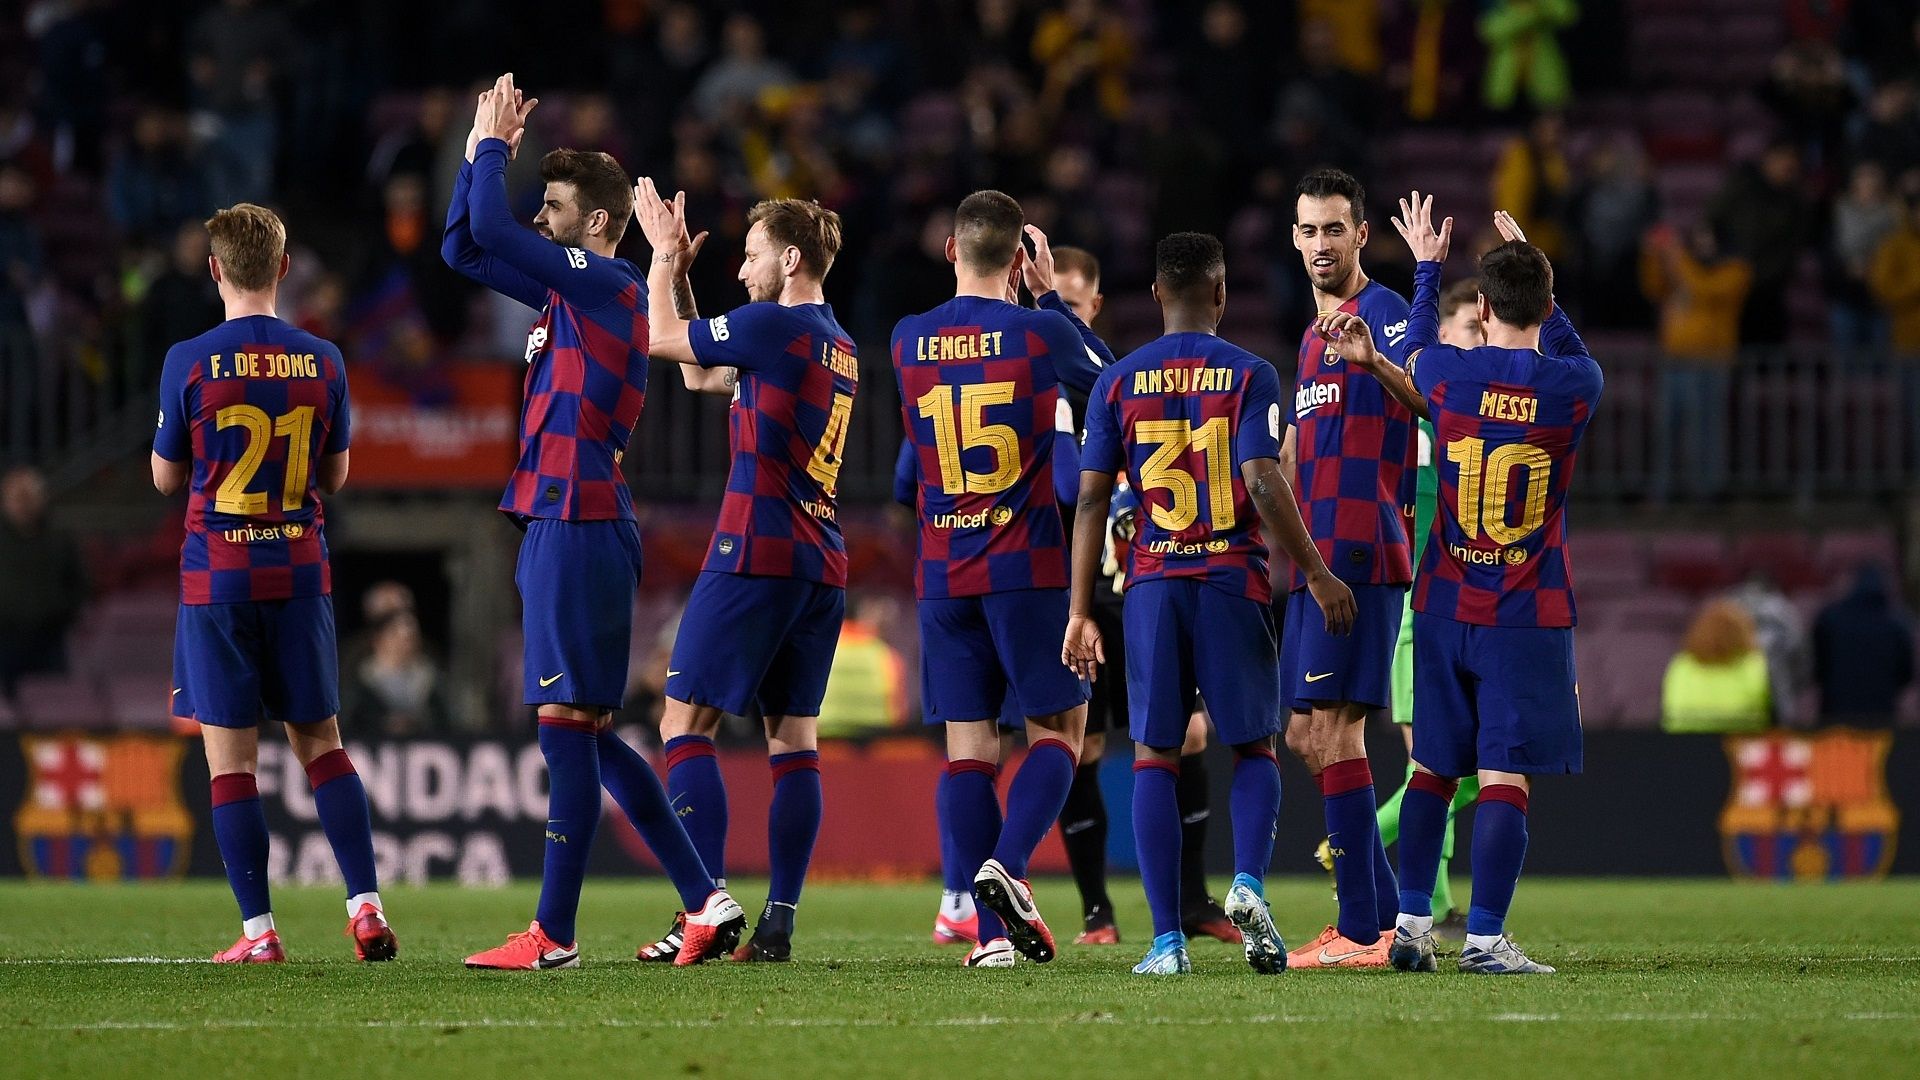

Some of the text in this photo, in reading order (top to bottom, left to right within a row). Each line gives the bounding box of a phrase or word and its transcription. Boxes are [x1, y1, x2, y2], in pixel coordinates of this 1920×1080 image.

[917, 331, 1002, 361] LENGLET
[210, 353, 318, 379] F. DE JONG
[1133, 367, 1233, 395] ANSU FATI
[1478, 390, 1538, 423] MESSI
[806, 392, 853, 499] 4
[916, 381, 1022, 495] 15
[214, 404, 316, 516] 21
[1134, 416, 1236, 532] 31
[1446, 435, 1552, 546] 10
[224, 523, 281, 543] unicef
[934, 508, 989, 529] unicef
[1149, 536, 1203, 555] unicef
[1450, 542, 1502, 566] unicef
[256, 740, 550, 822] FUNDAC
